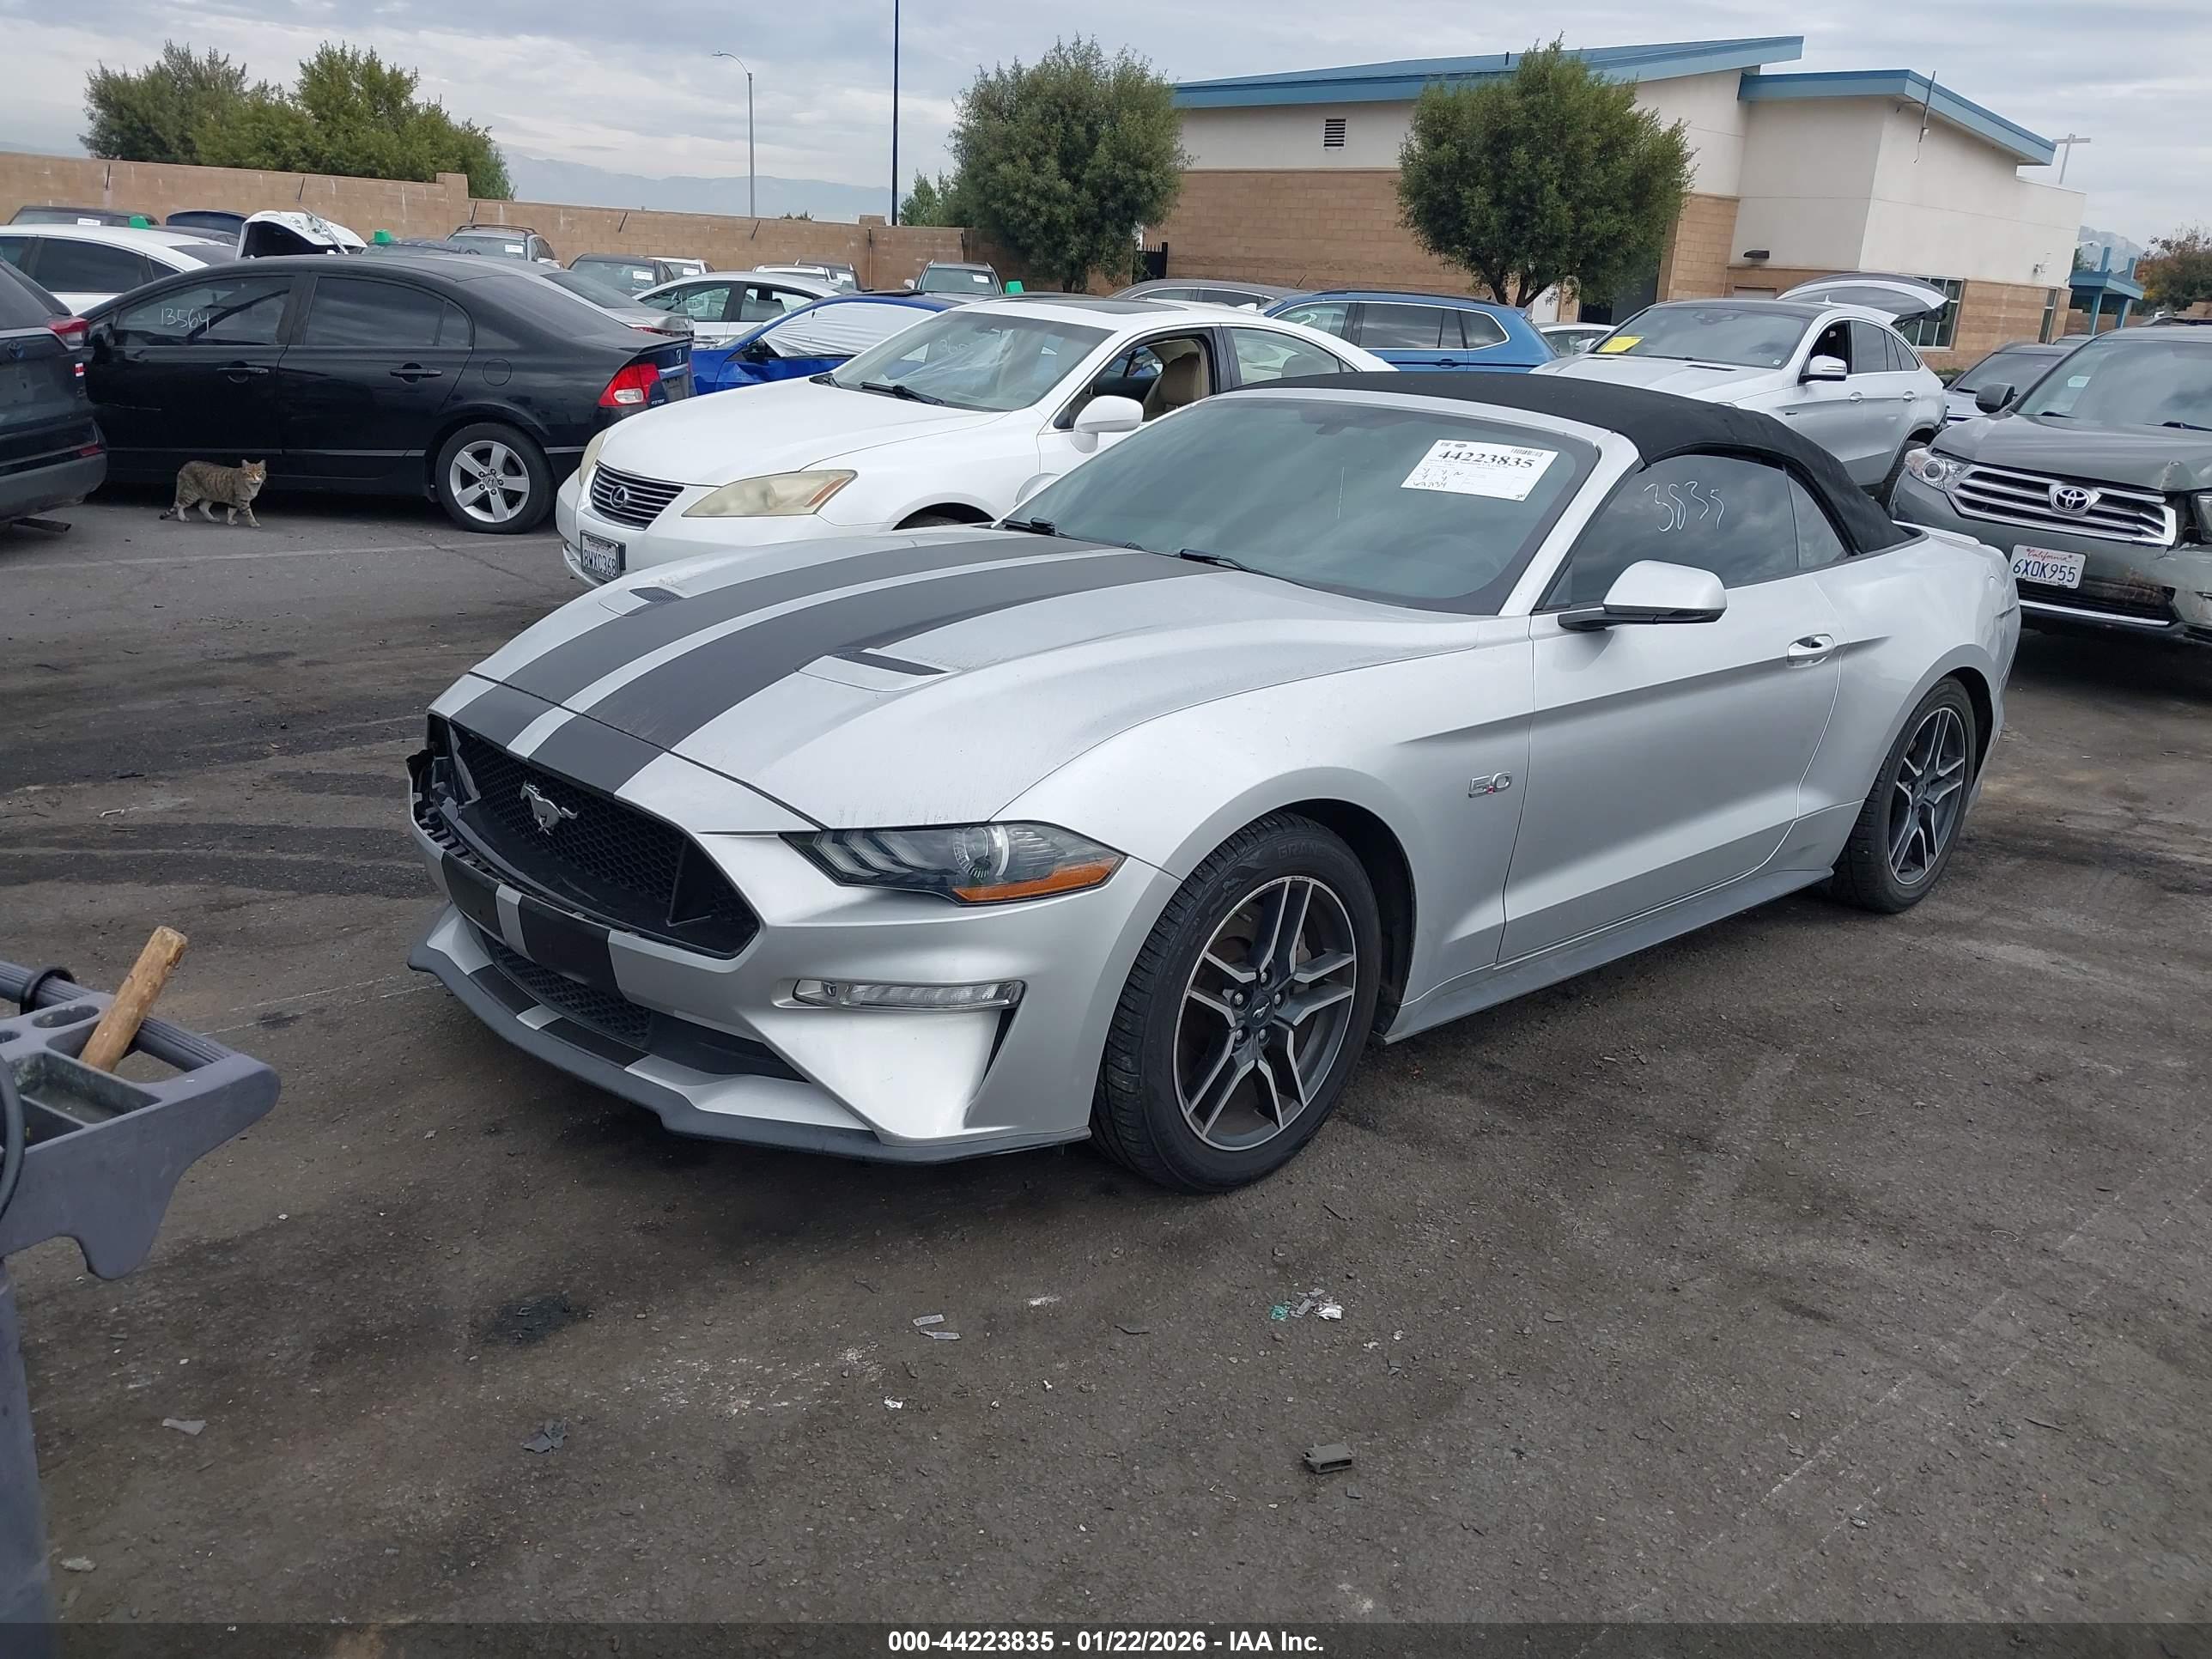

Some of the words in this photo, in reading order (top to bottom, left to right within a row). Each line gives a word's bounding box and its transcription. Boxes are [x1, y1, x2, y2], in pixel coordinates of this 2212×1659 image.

[161, 308, 210, 333] 13564
[1437, 450, 1535, 469] 44223835
[1644, 481, 1724, 532] 3835
[584, 549, 617, 577] 8WXC368
[2027, 549, 2071, 563] California
[1468, 771, 1512, 799] 5.0
